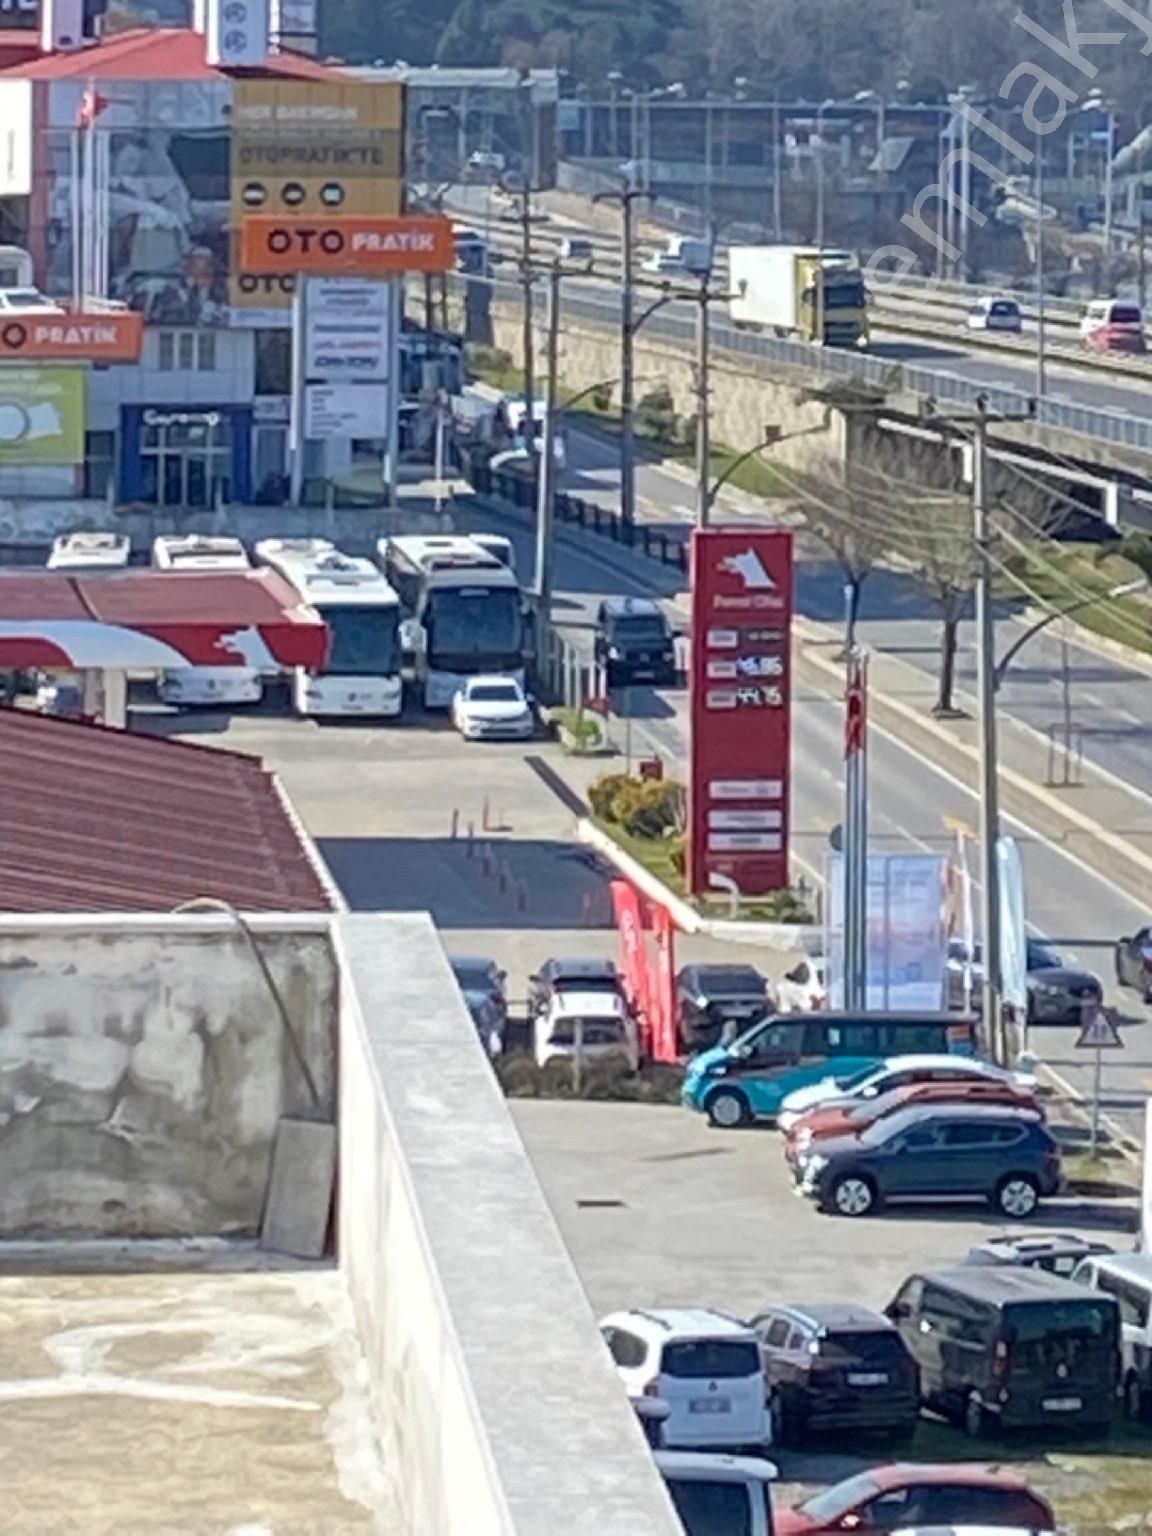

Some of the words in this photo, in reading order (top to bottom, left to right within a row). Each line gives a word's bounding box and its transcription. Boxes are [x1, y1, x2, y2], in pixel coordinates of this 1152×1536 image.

[267, 228, 345, 254] OTO
[352, 230, 434, 252] PRATİK
[35, 323, 118, 344] PRATİK
